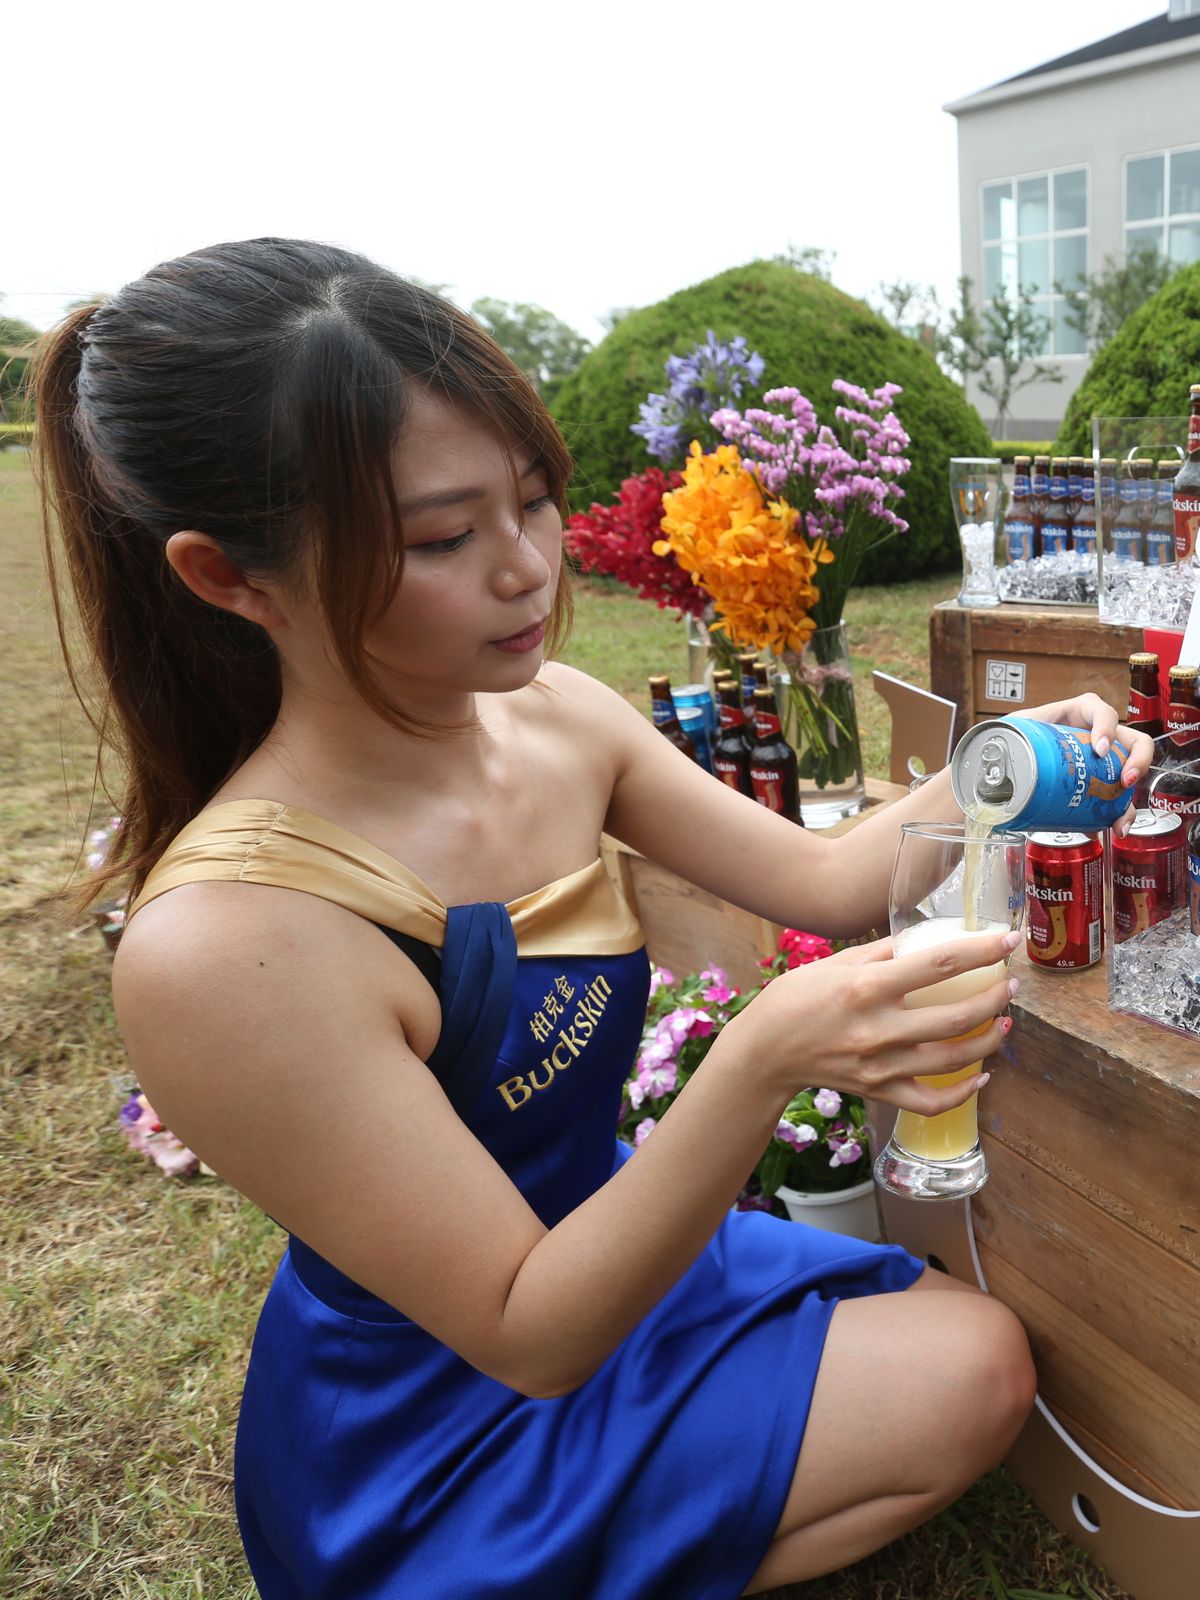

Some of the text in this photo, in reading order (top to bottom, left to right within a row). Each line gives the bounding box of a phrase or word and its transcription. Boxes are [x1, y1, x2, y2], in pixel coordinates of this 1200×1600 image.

[496, 974, 613, 1112] Buckskin
[529, 974, 576, 1043] 柏克金
